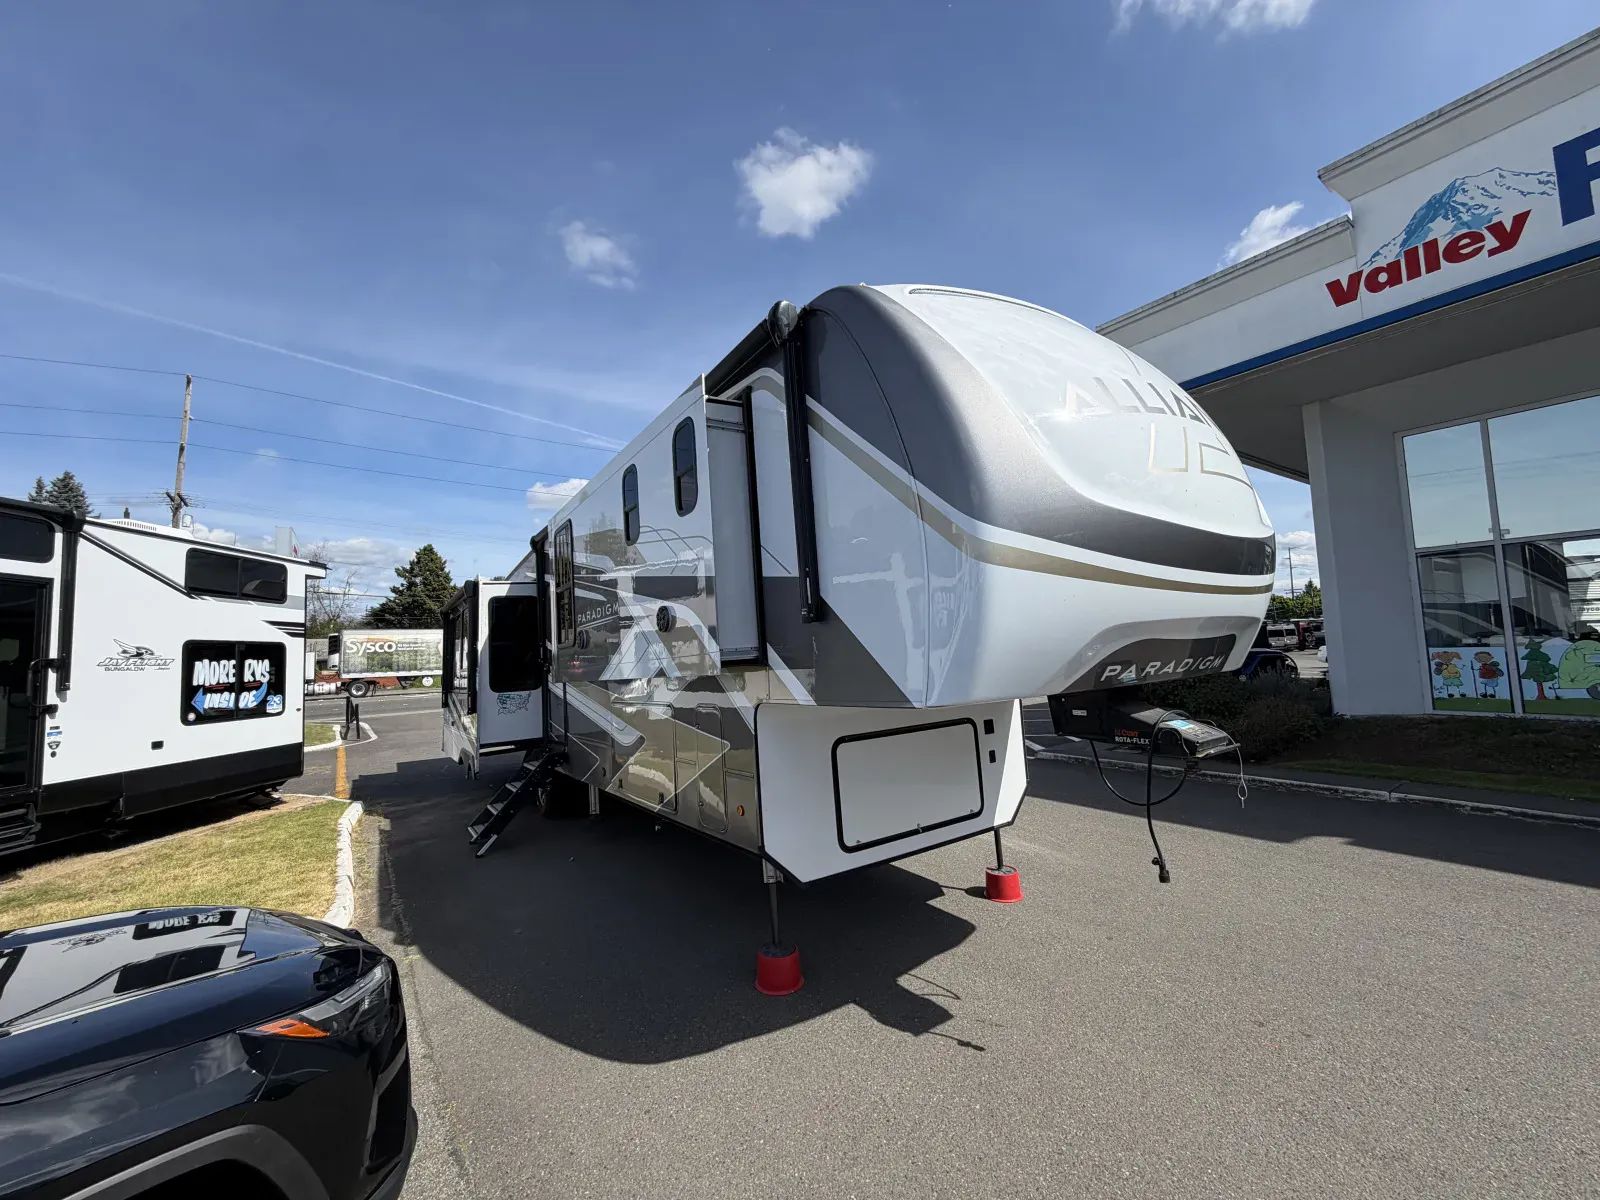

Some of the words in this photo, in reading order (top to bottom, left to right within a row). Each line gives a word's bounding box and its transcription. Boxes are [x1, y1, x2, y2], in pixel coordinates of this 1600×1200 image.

[1325, 209, 1532, 308] valley
[577, 601, 620, 623] PARADIGM
[345, 639, 396, 656] Sysco
[192, 658, 237, 686] MORE
[1100, 655, 1225, 682] PARADIGM
[1115, 736, 1150, 745] ROTA-FLEX
